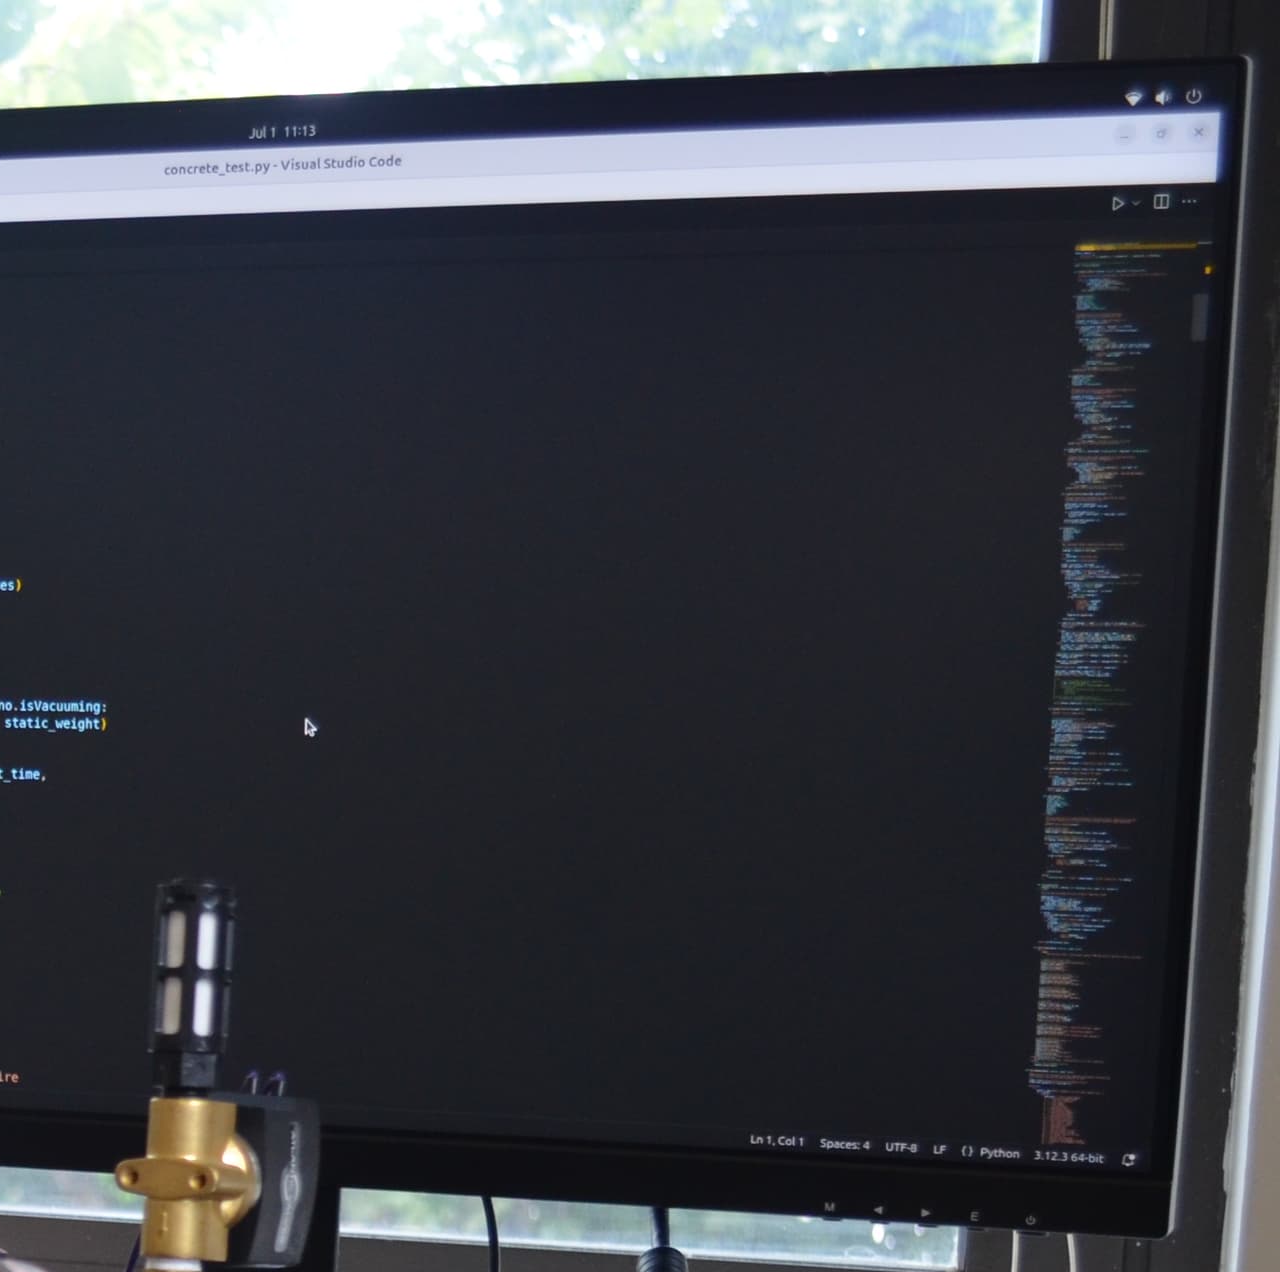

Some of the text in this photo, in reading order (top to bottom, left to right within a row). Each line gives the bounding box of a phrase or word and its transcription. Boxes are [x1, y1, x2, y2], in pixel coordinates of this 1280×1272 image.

[249, 124, 317, 140] Jul 11:13
[164, 153, 402, 177] concrete_test.py Visual Studio Code
[5, 713, 106, 732] static_weight)
[750, 1133, 1105, 1165] Ln Col Spaces: UTF-8 LF Python 3.12.3 64-bit
